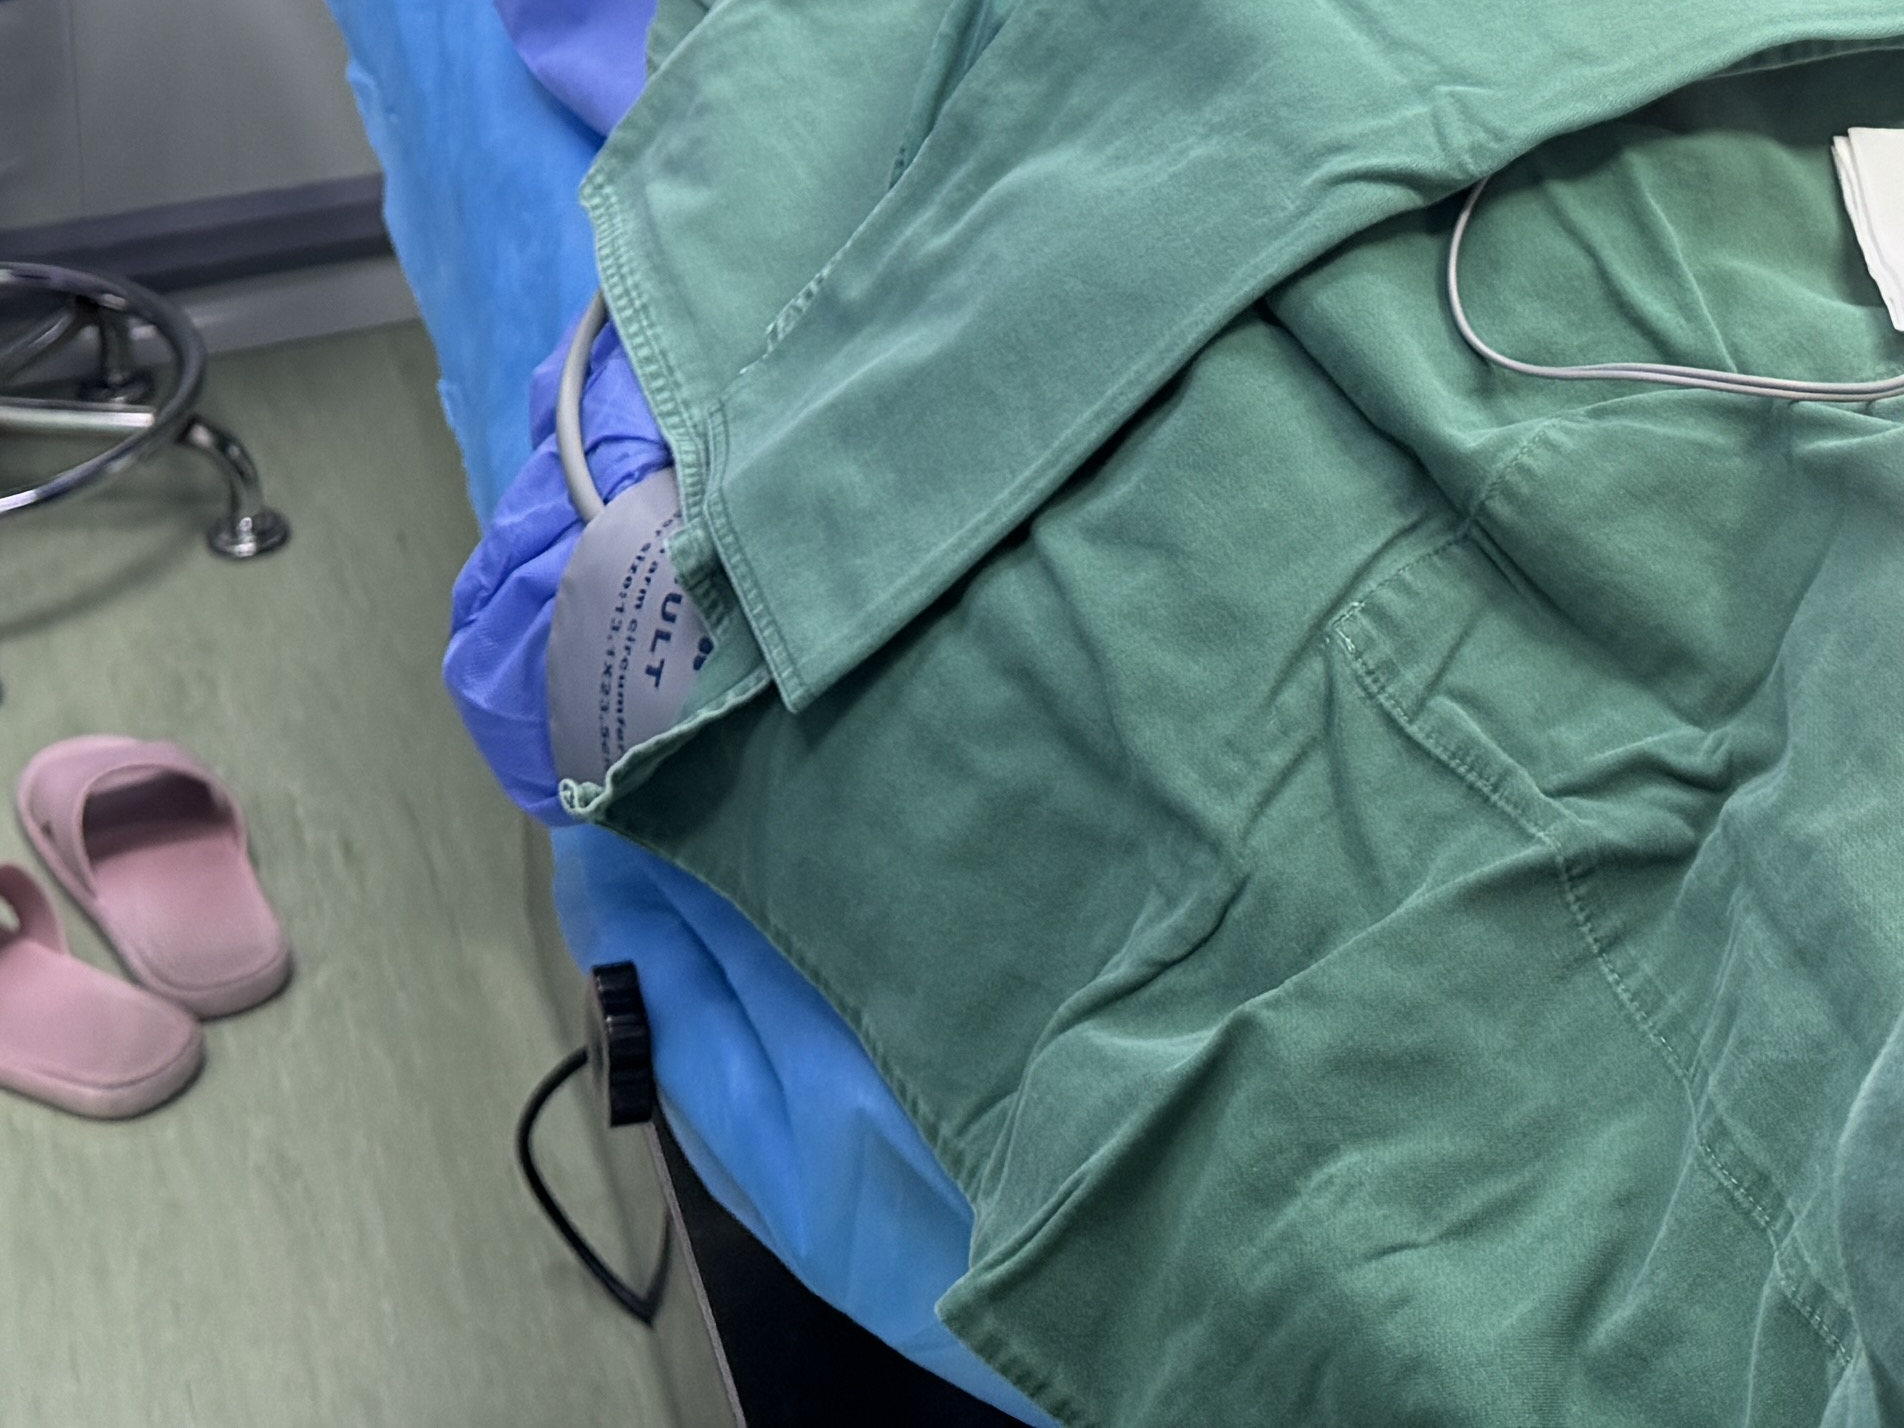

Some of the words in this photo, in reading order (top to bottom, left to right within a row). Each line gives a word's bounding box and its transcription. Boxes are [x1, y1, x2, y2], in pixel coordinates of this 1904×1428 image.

[635, 560, 658, 610] arm
[645, 577, 683, 690] ULT
[615, 617, 638, 755] circumfer
